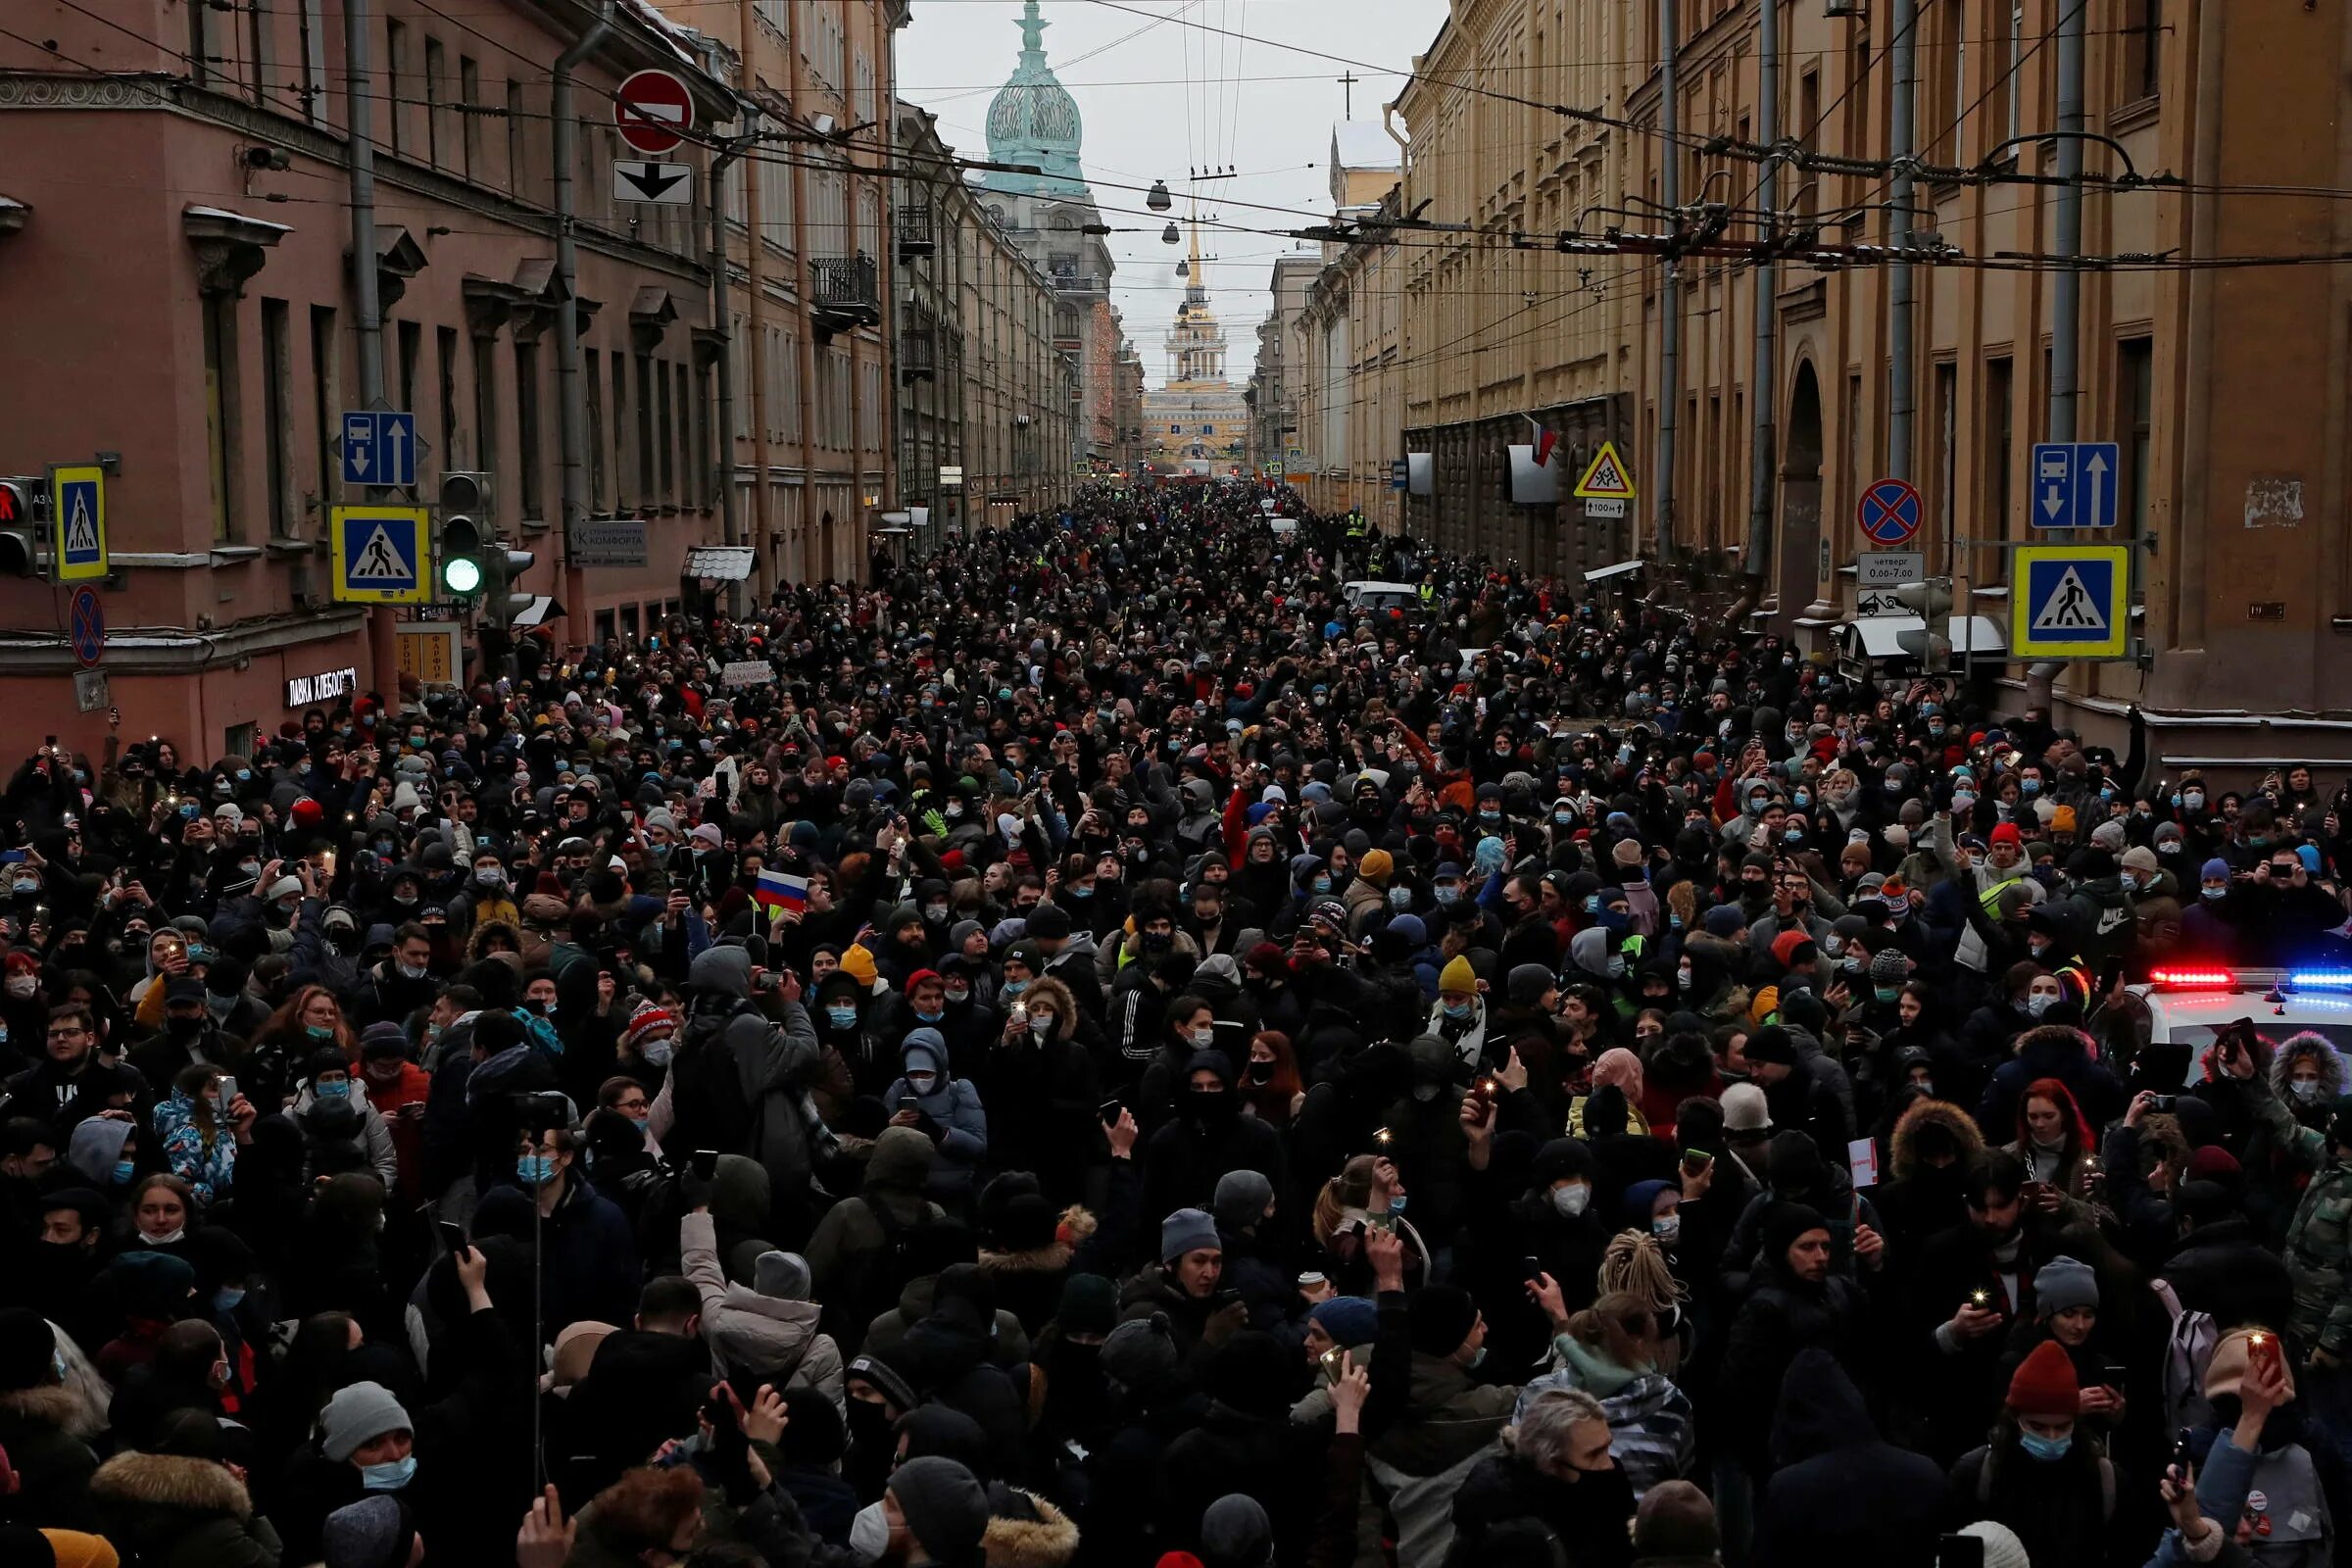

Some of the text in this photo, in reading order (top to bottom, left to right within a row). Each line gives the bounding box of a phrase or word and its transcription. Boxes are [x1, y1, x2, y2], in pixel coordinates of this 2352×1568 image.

[589, 536, 644, 546] КОМФОРТА
[431, 635, 442, 679] ФАРФОР
[289, 676, 313, 708] ЛАВКА
[2102, 907, 2125, 922] NIKE
